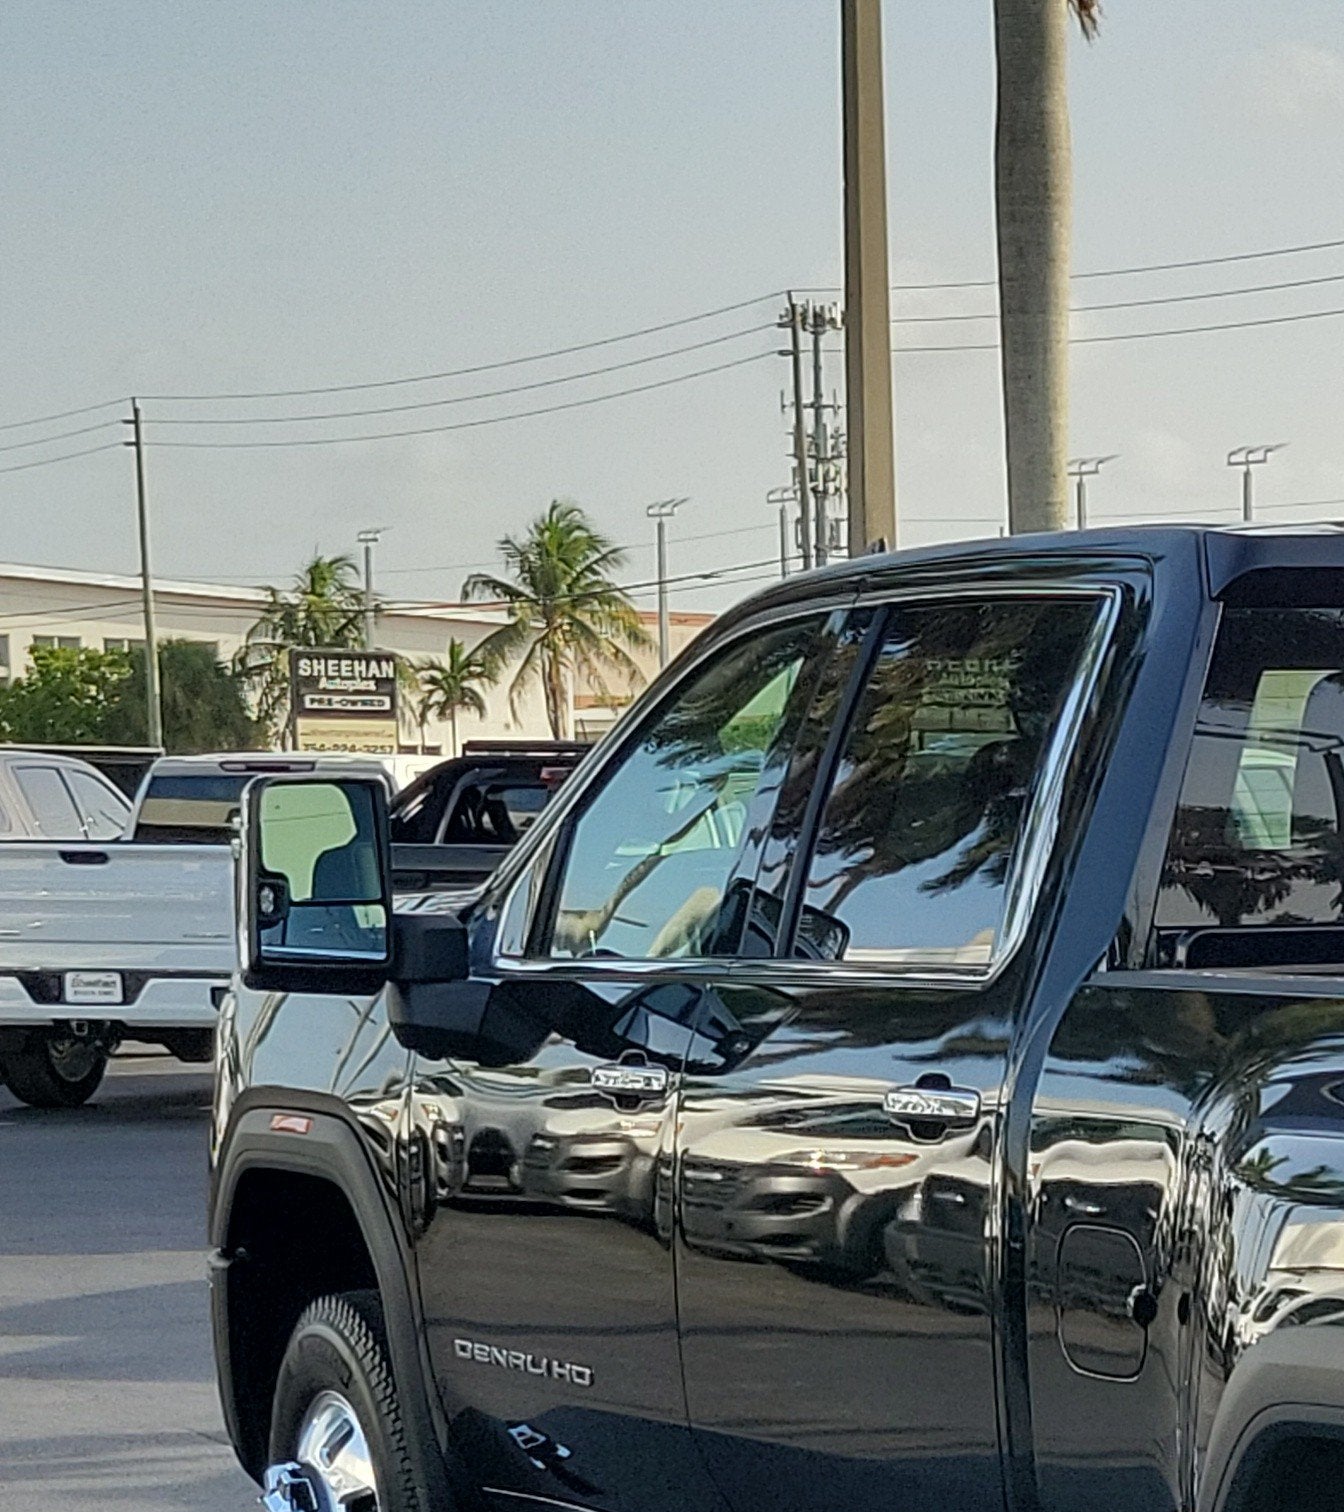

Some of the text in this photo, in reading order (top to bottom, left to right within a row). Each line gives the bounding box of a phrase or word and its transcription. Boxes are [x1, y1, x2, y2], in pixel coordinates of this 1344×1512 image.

[298, 658, 394, 678] SHEEHAN
[454, 1338, 596, 1387] DENALI HD
